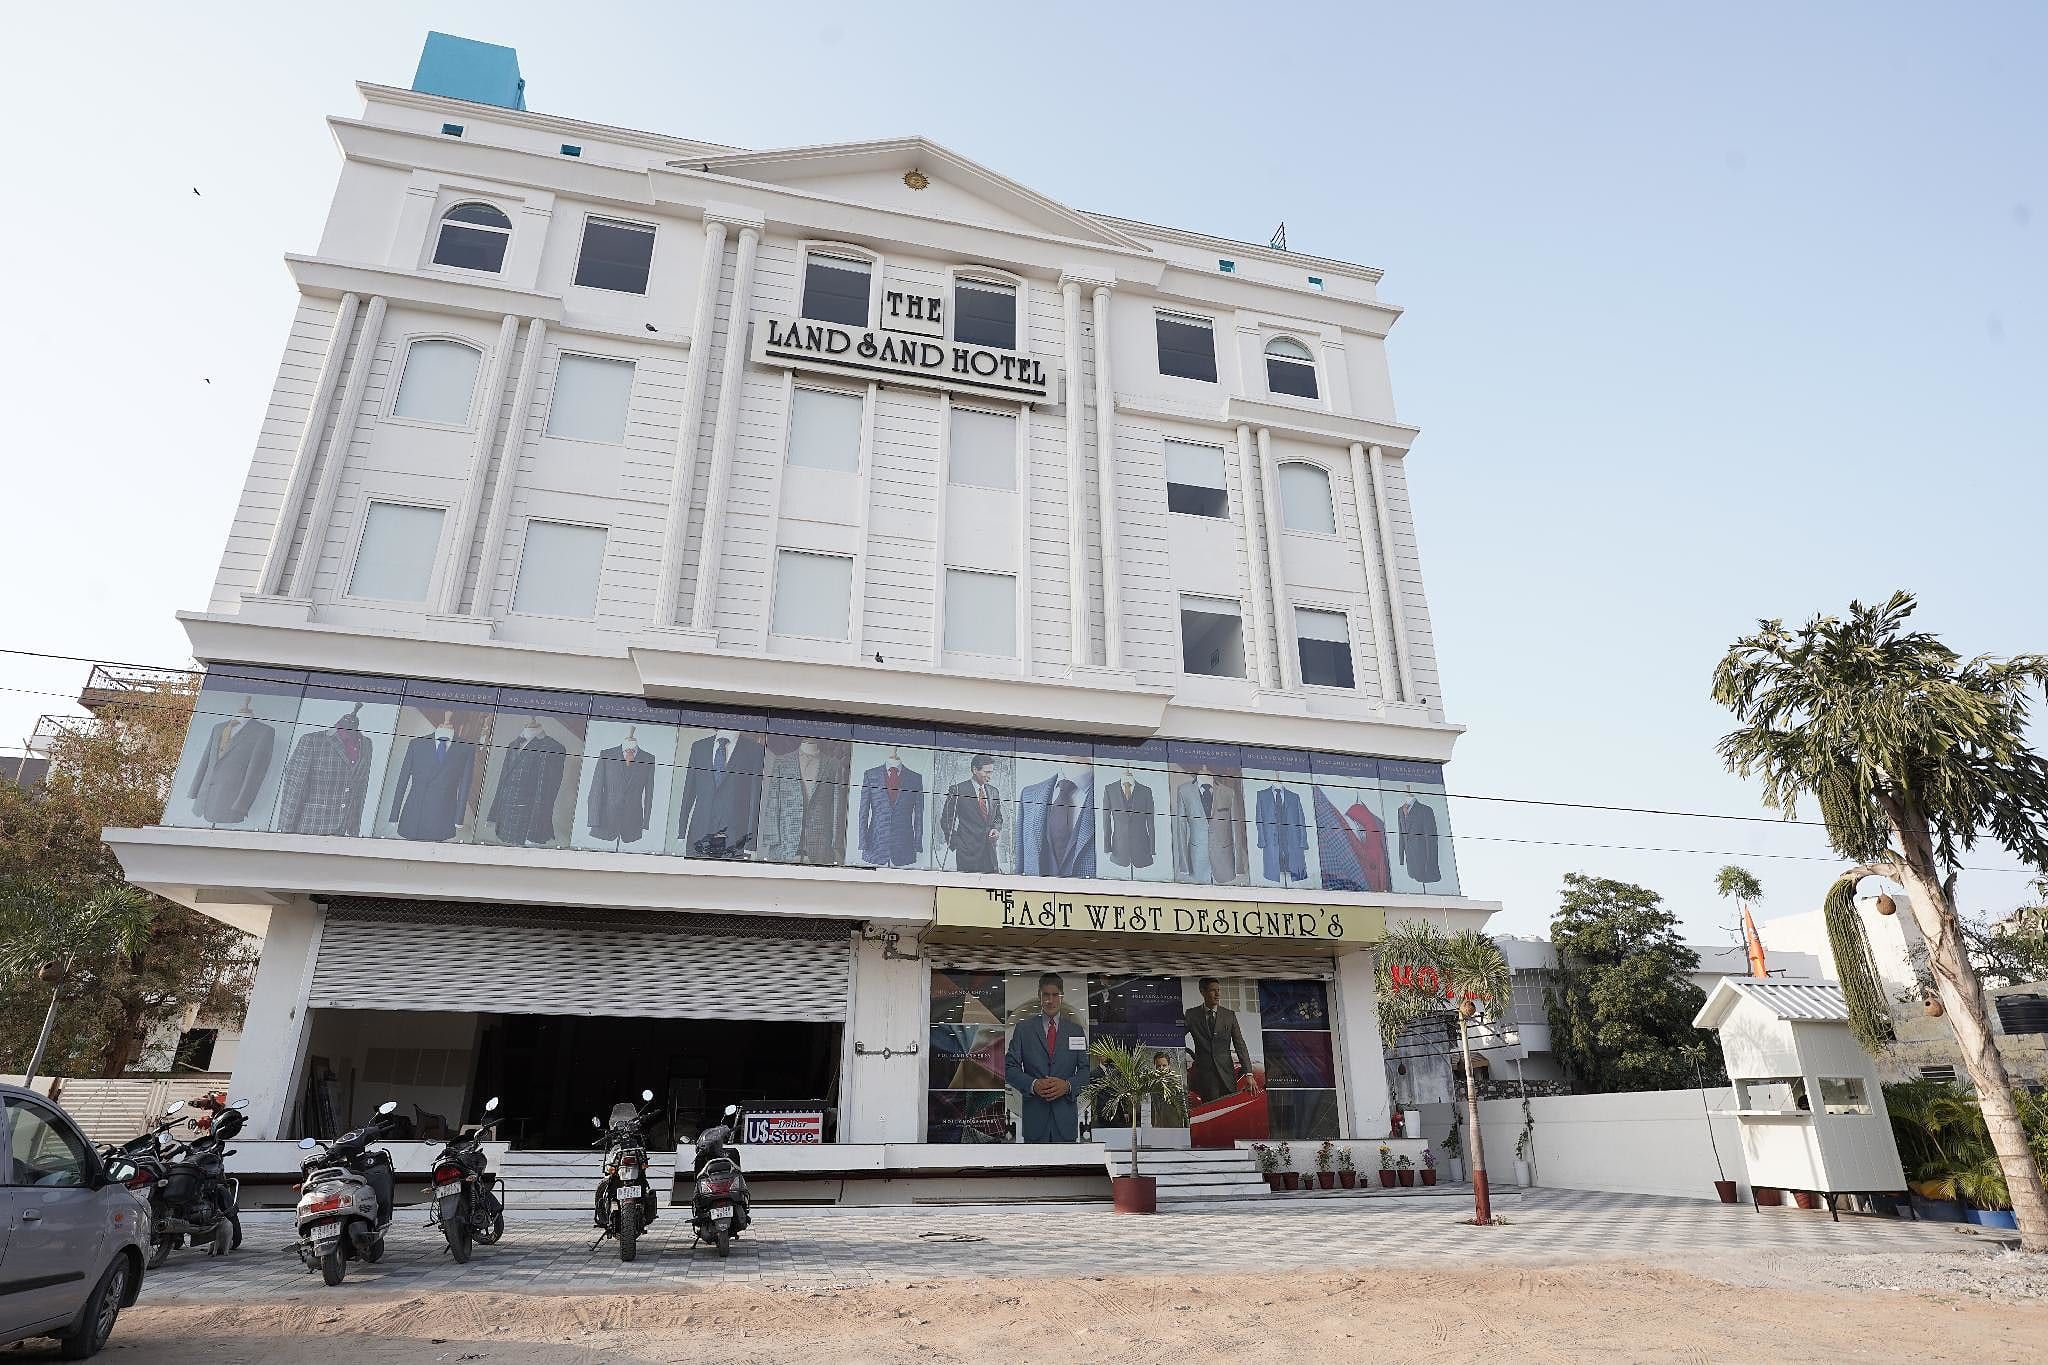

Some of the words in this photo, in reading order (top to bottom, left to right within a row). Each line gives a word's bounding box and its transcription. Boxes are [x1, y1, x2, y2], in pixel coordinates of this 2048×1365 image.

[886, 290, 941, 322] THE
[767, 319, 851, 353] LAND
[857, 332, 945, 367] SAND
[951, 347, 1046, 386] HOTEL
[986, 889, 1013, 902] THE
[1001, 900, 1073, 930] EAST
[1083, 904, 1163, 931] WEST
[1174, 908, 1345, 938] DESIGNER'S
[778, 1119, 808, 1128] Dollar
[772, 1130, 814, 1142] Store
